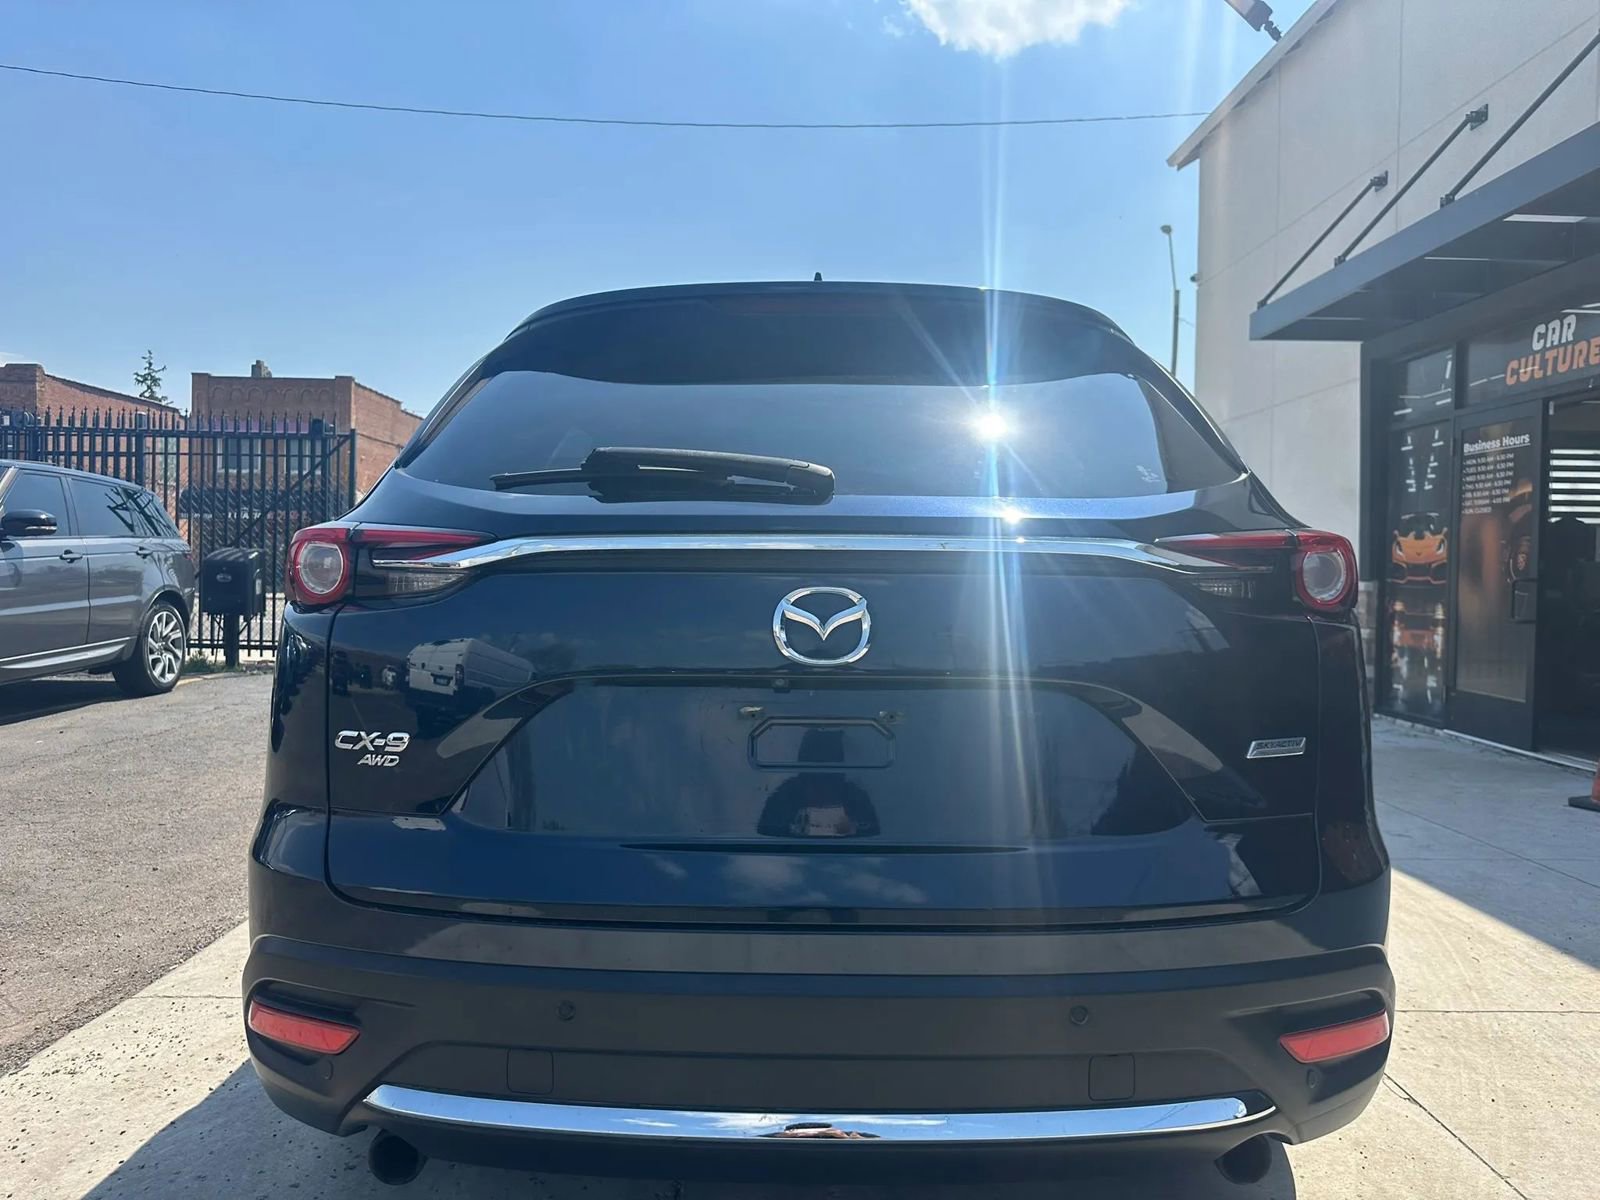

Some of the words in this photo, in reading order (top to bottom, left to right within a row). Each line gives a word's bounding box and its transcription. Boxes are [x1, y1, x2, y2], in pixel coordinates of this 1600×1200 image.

[1532, 314, 1576, 351] CAR
[1505, 336, 1600, 385] CULTURE
[1464, 440, 1500, 453] Business
[1503, 434, 1530, 446] Hours
[334, 730, 411, 752] CX-9
[357, 753, 400, 767] AWD
